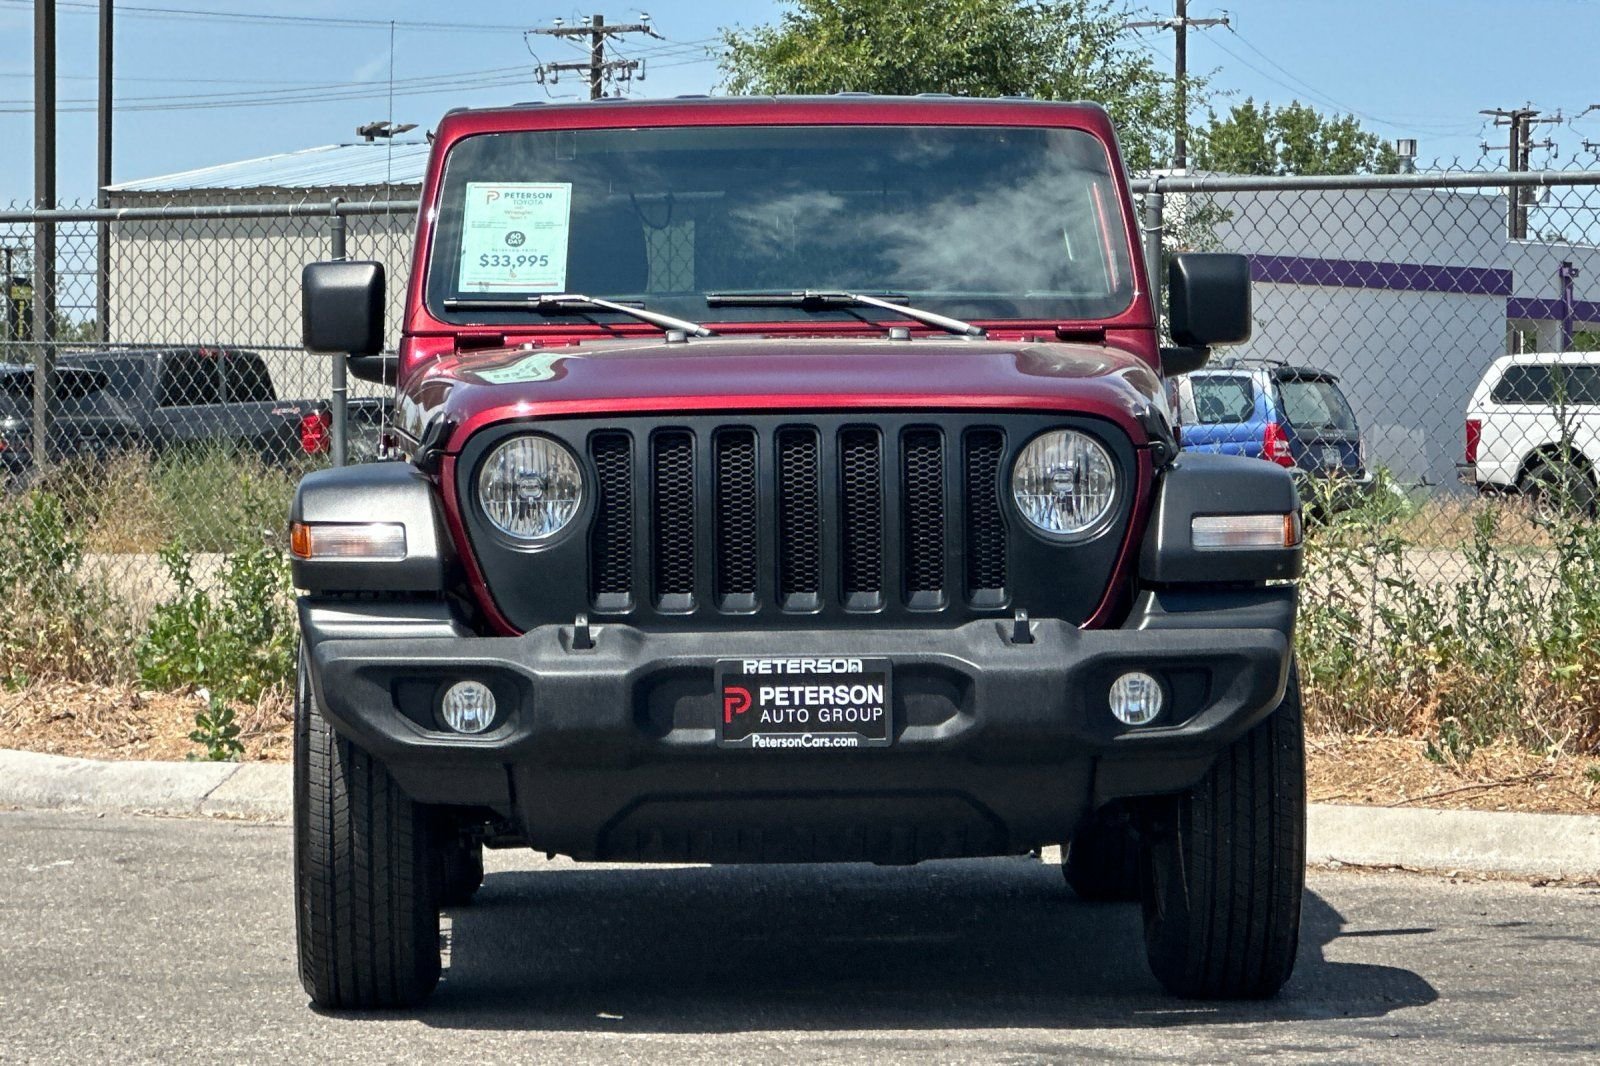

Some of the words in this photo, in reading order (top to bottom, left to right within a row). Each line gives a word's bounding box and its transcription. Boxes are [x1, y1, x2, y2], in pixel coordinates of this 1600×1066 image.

[479, 252, 548, 269] $33,995
[759, 685, 884, 706] PETERSON
[760, 708, 809, 723] AUTO
[818, 707, 883, 722] GROUP
[752, 734, 857, 748] PetersonCars.com
